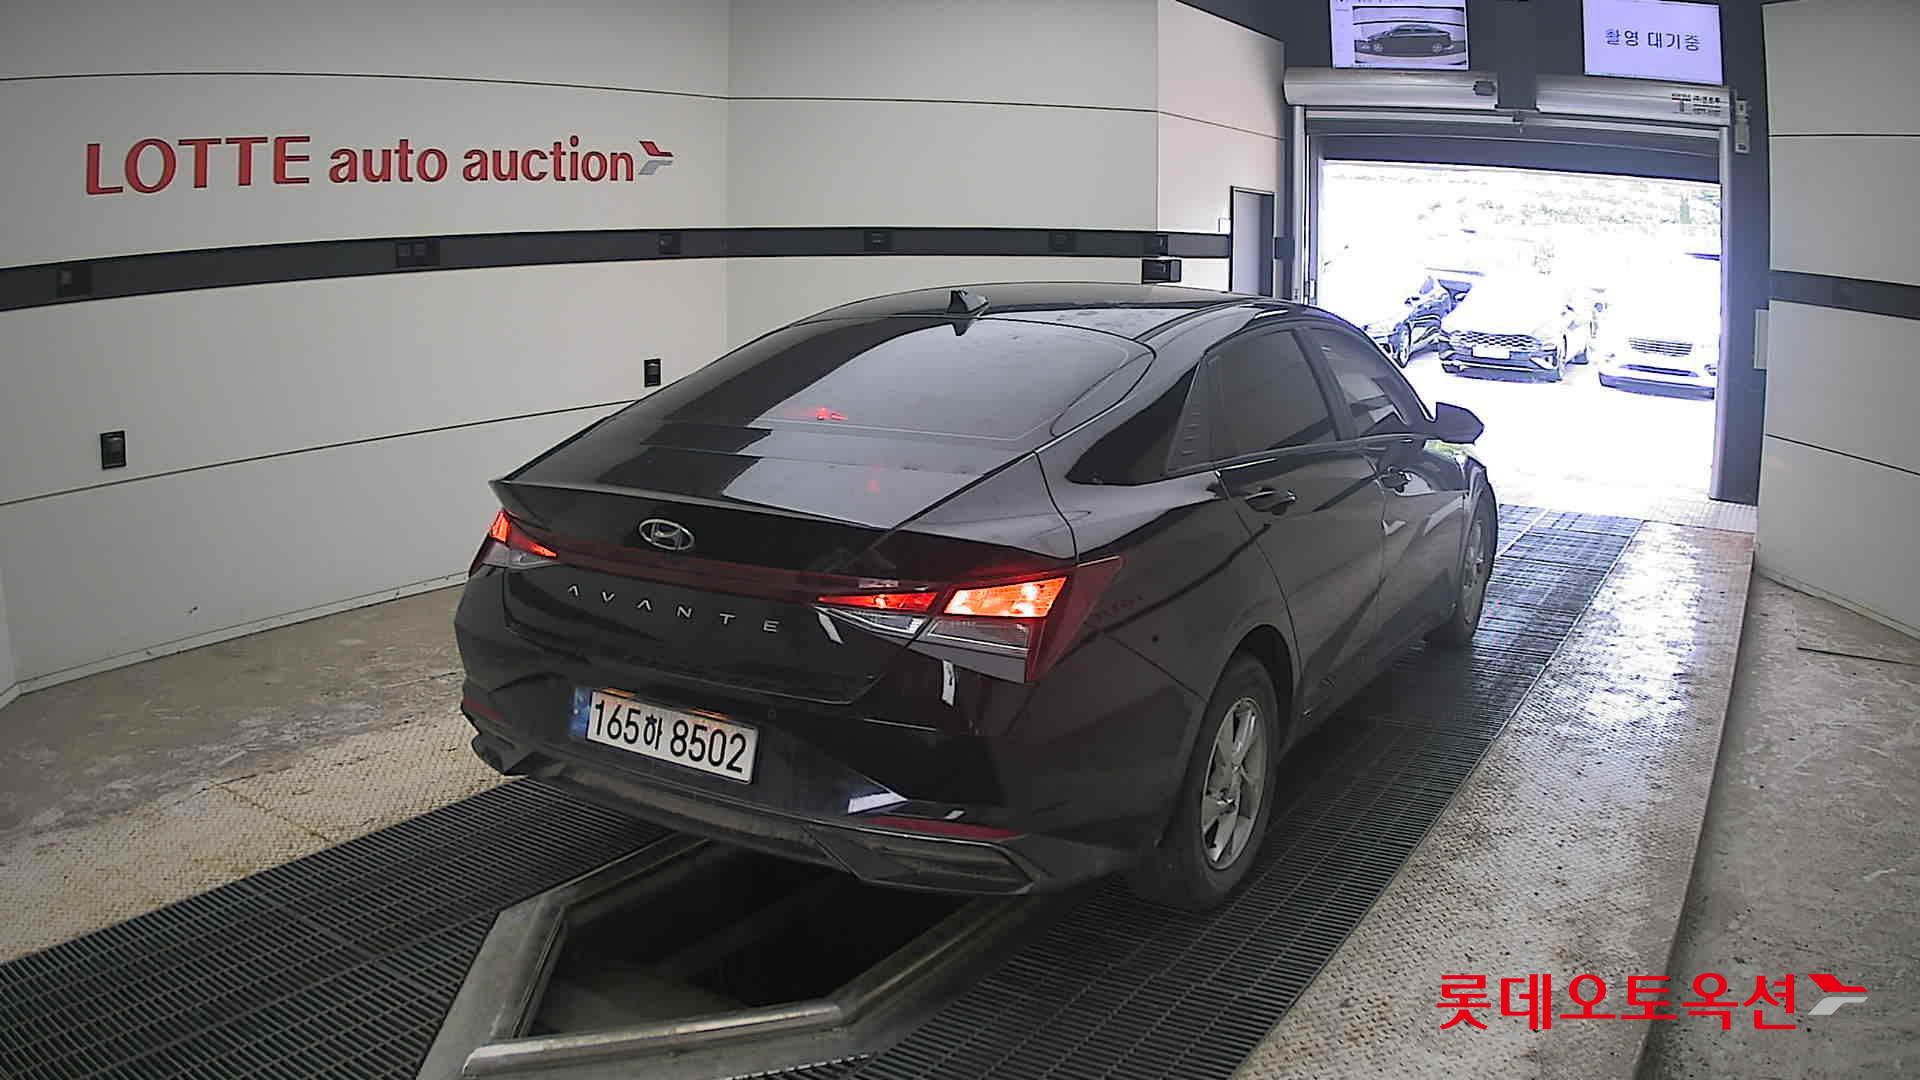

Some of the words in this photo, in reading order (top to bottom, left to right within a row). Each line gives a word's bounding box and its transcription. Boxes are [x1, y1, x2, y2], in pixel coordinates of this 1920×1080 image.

[1647, 31, 1700, 52] 대기중
[85, 135, 310, 195] LOTTE
[328, 138, 448, 184] auto
[462, 135, 635, 183] auction
[567, 584, 780, 633] AVANTE
[594, 699, 663, 751] 165하
[670, 719, 747, 774] 8502
